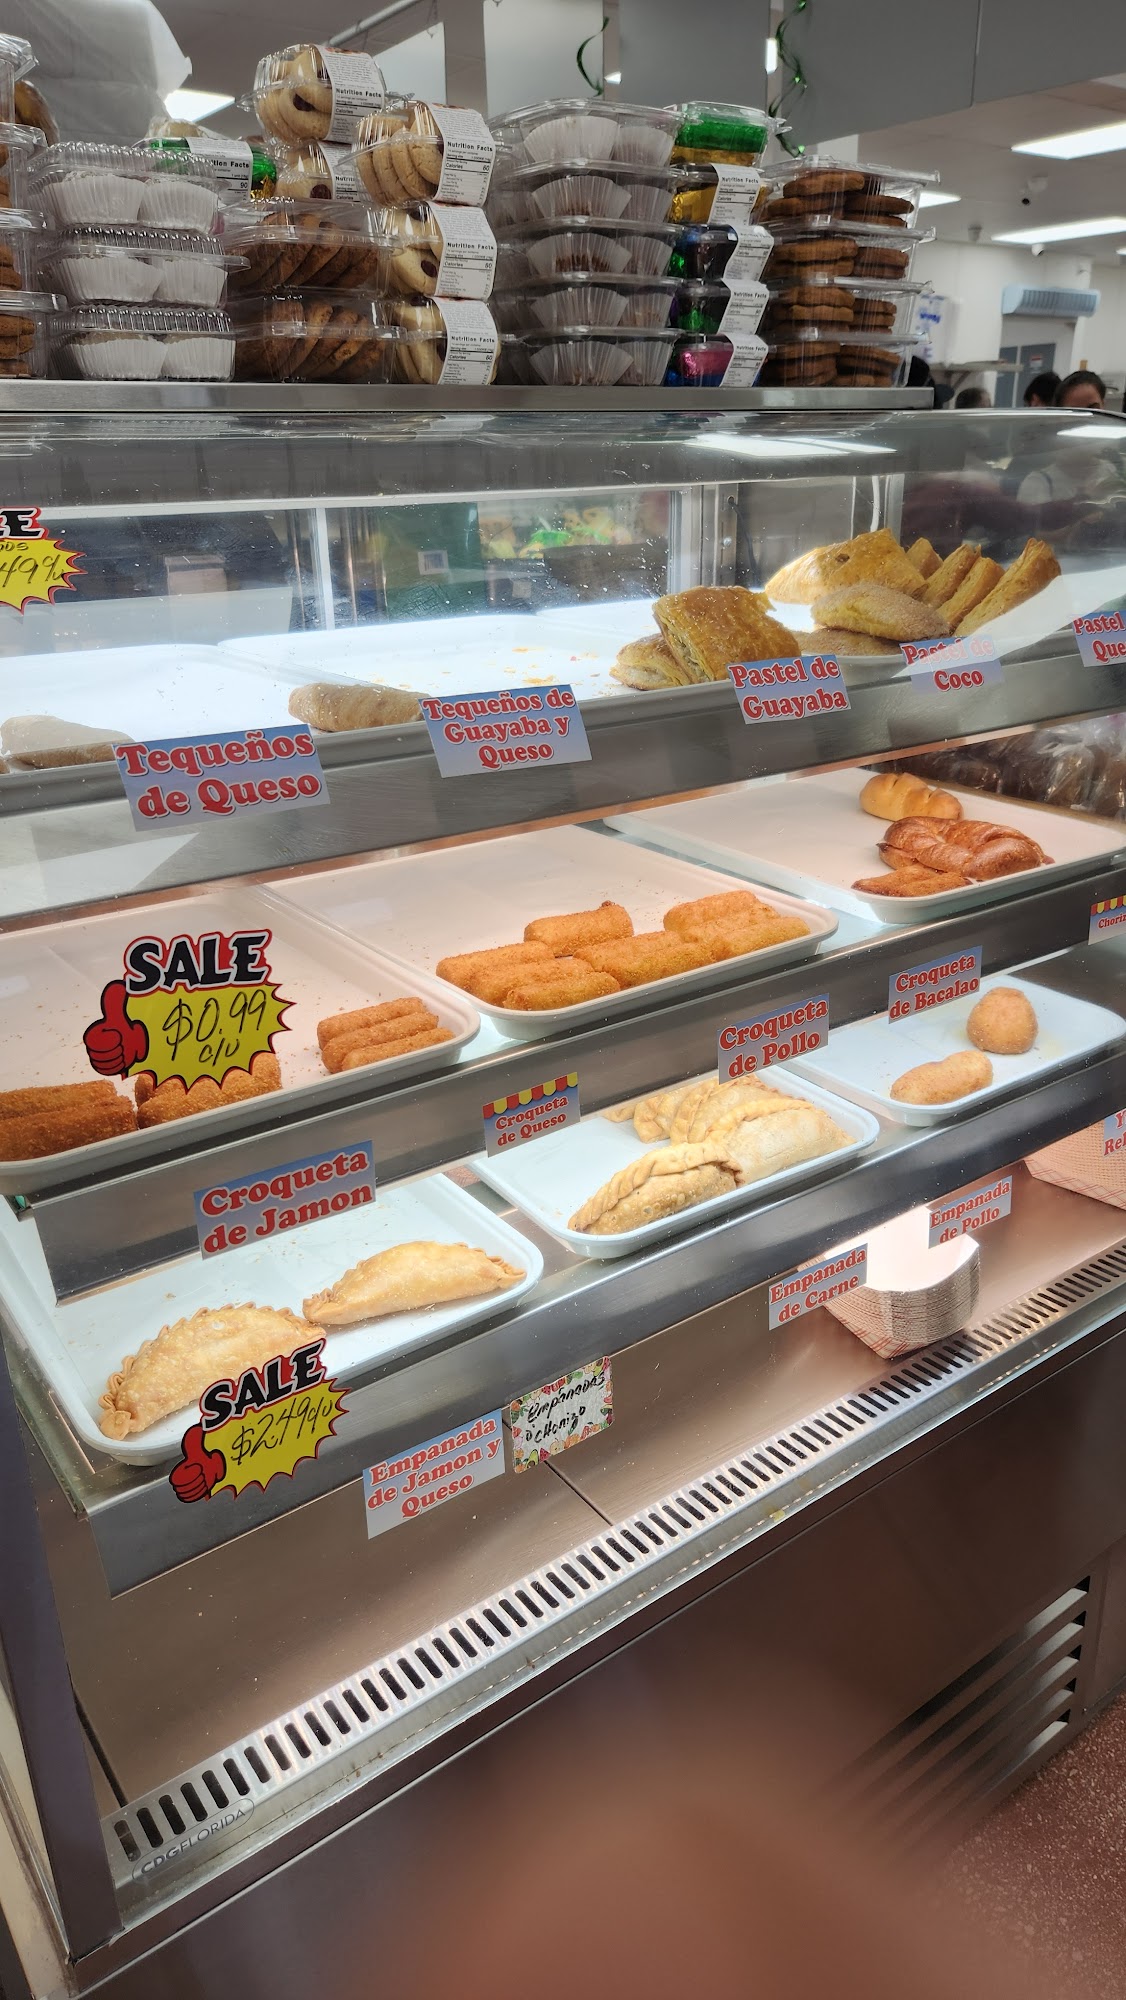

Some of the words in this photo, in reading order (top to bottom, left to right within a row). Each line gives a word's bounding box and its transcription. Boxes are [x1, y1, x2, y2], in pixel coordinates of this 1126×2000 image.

[336, 88, 363, 96] Nutrition
[366, 90, 381, 98] Facts
[447, 141, 475, 150] Nutrition
[477, 144, 493, 152] Facts
[1073, 612, 1126, 636] Pastel
[728, 658, 809, 689] Pastel
[810, 655, 841, 679] de
[901, 637, 969, 666] Pastel
[970, 638, 995, 657] de
[742, 686, 849, 719] Guayaba
[933, 669, 985, 692] Coco
[422, 691, 544, 722] Tequeños
[546, 687, 576, 709] de
[443, 715, 552, 744] Guayaba
[553, 715, 571, 737] y
[115, 729, 316, 777] Tequeños
[478, 742, 554, 771] Queso
[136, 783, 192, 819] de
[196, 773, 321, 816] Queso
[126, 933, 270, 993] SALE
[895, 954, 976, 993] Croqueta
[889, 999, 911, 1019] de
[914, 977, 980, 1011] Bacalao
[162, 989, 267, 1062] $0.99
[719, 999, 829, 1051] Croqueta
[728, 1053, 757, 1079] de
[761, 1030, 821, 1067] Pollo
[495, 1095, 569, 1131] Croqueta
[496, 1131, 517, 1147] de
[519, 1112, 567, 1139] Queso
[200, 1150, 370, 1217] Croqueta
[929, 1179, 1011, 1229] Empanada
[202, 1222, 249, 1254] de
[254, 1184, 374, 1238] Jamon
[939, 1226, 959, 1244] de
[960, 1206, 1001, 1235] Pollo
[769, 1248, 867, 1305] Empanada
[778, 1302, 801, 1323] de
[804, 1274, 859, 1309] Carne
[202, 1339, 324, 1432] SALE
[367, 1486, 398, 1510] de
[401, 1446, 484, 1494] Jamon
[486, 1437, 502, 1459] y
[369, 1418, 497, 1487] Empanada
[400, 1474, 474, 1519] Queso
[140, 1808, 246, 1875] CDGFLORIDA
